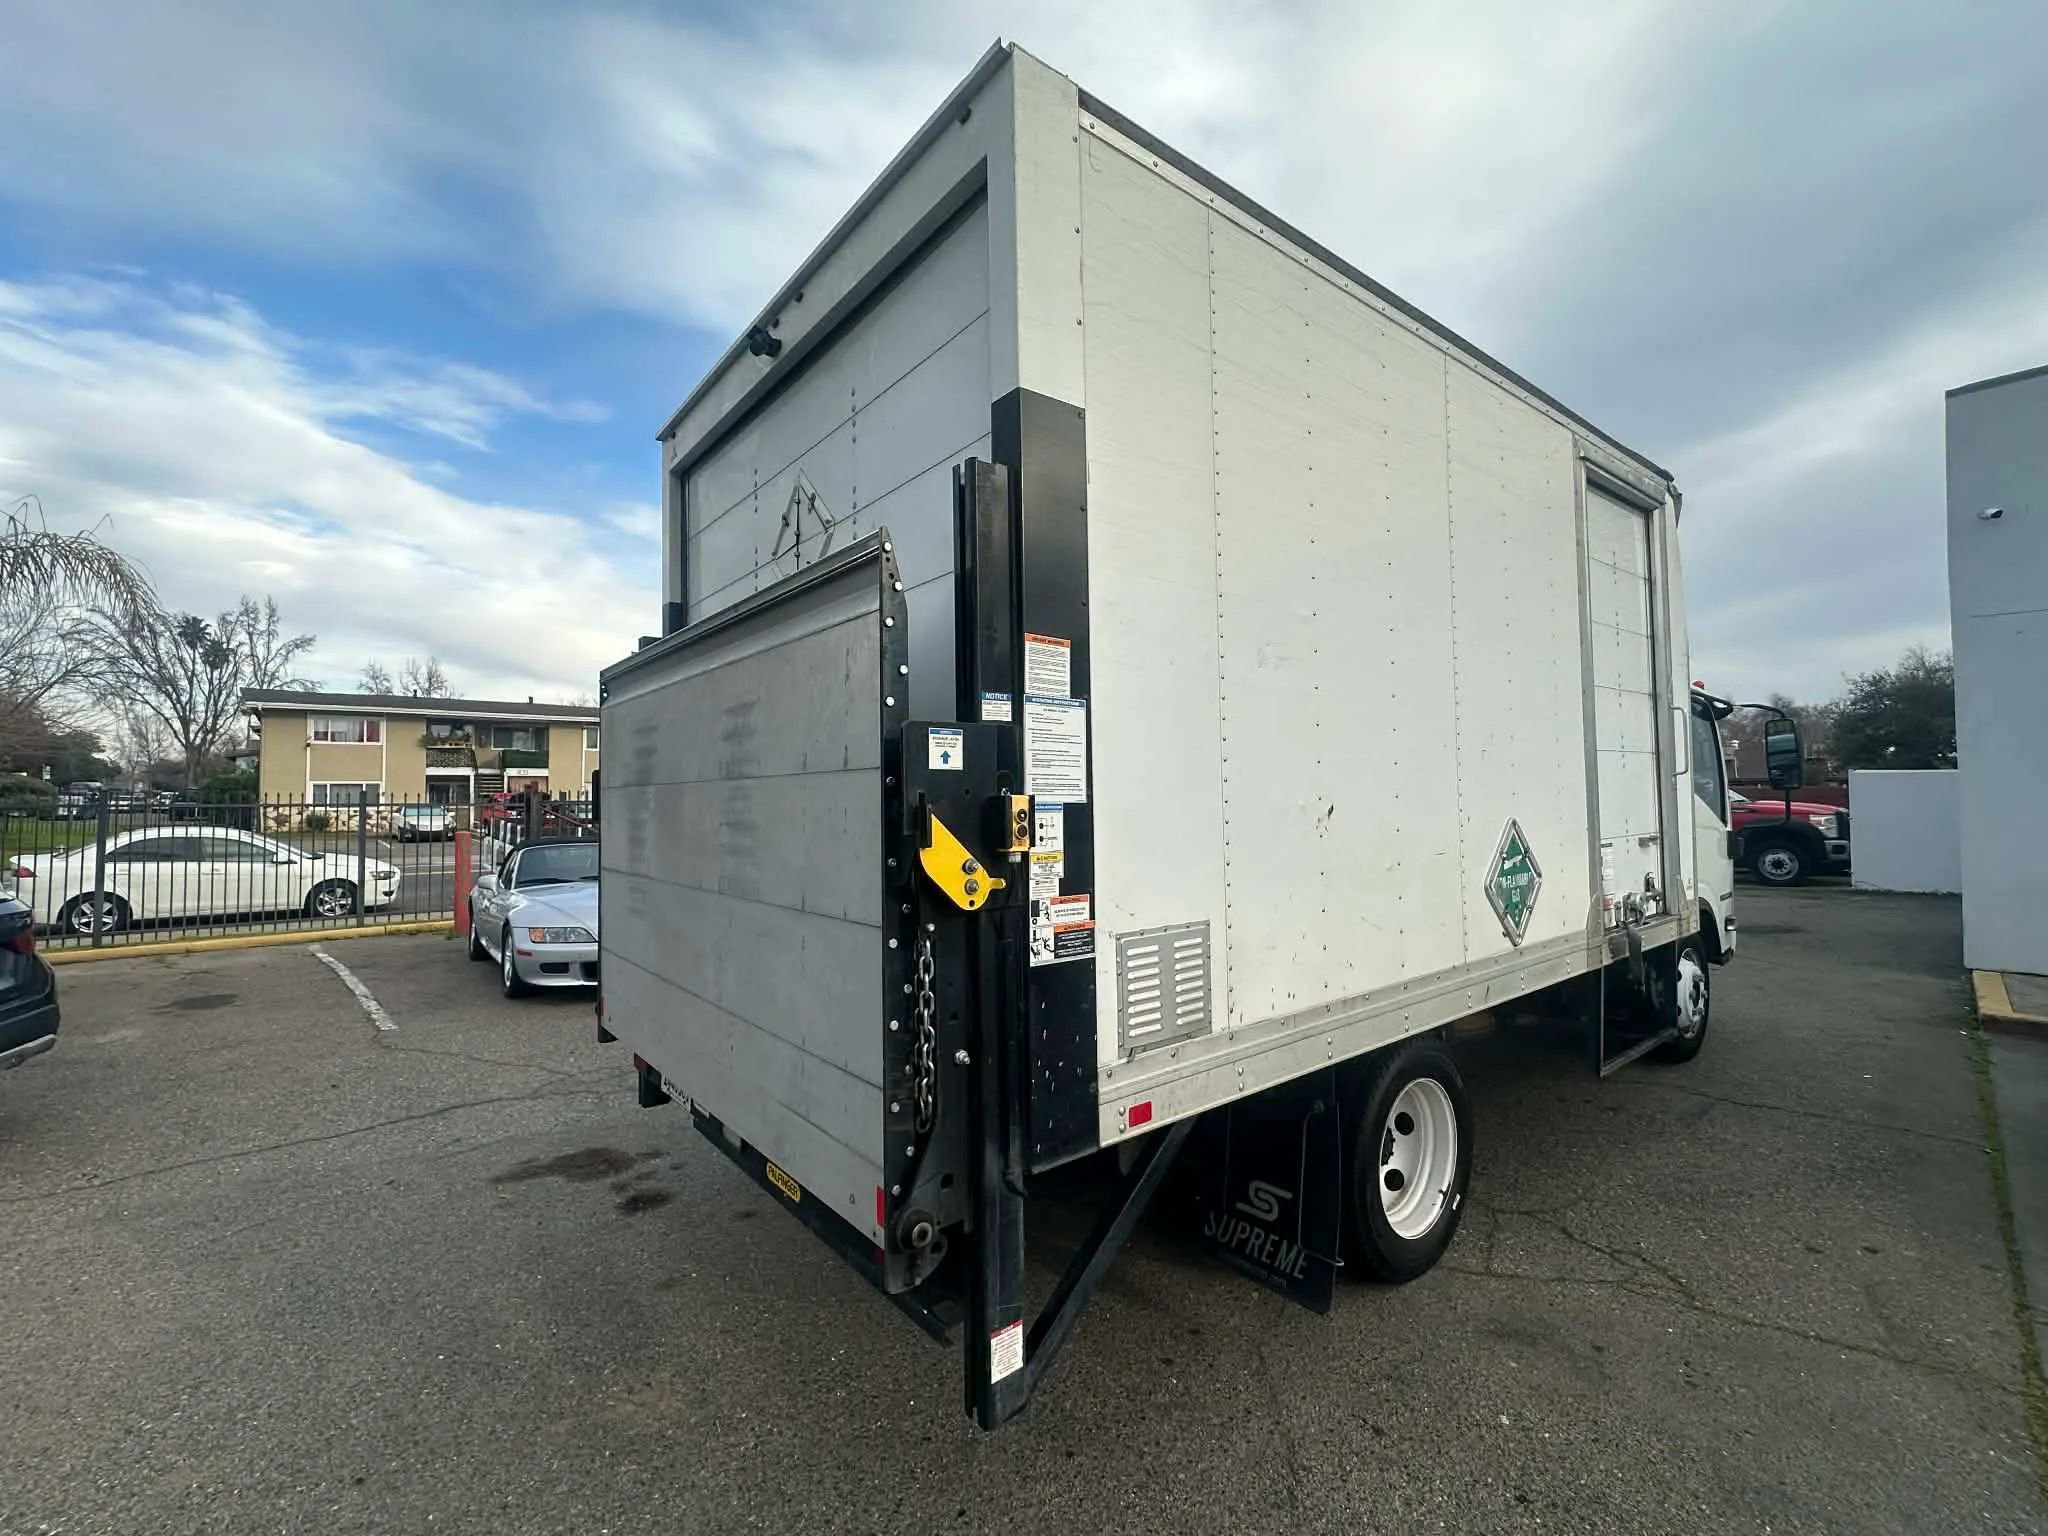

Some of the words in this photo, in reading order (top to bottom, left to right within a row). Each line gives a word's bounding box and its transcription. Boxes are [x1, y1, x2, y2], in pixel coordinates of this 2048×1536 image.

[985, 692, 1008, 701] NOTICE
[1498, 872, 1531, 888] N-FLAMMABL
[767, 1165, 799, 1201] PALFINGER
[1204, 1210, 1308, 1280] SUPREME
